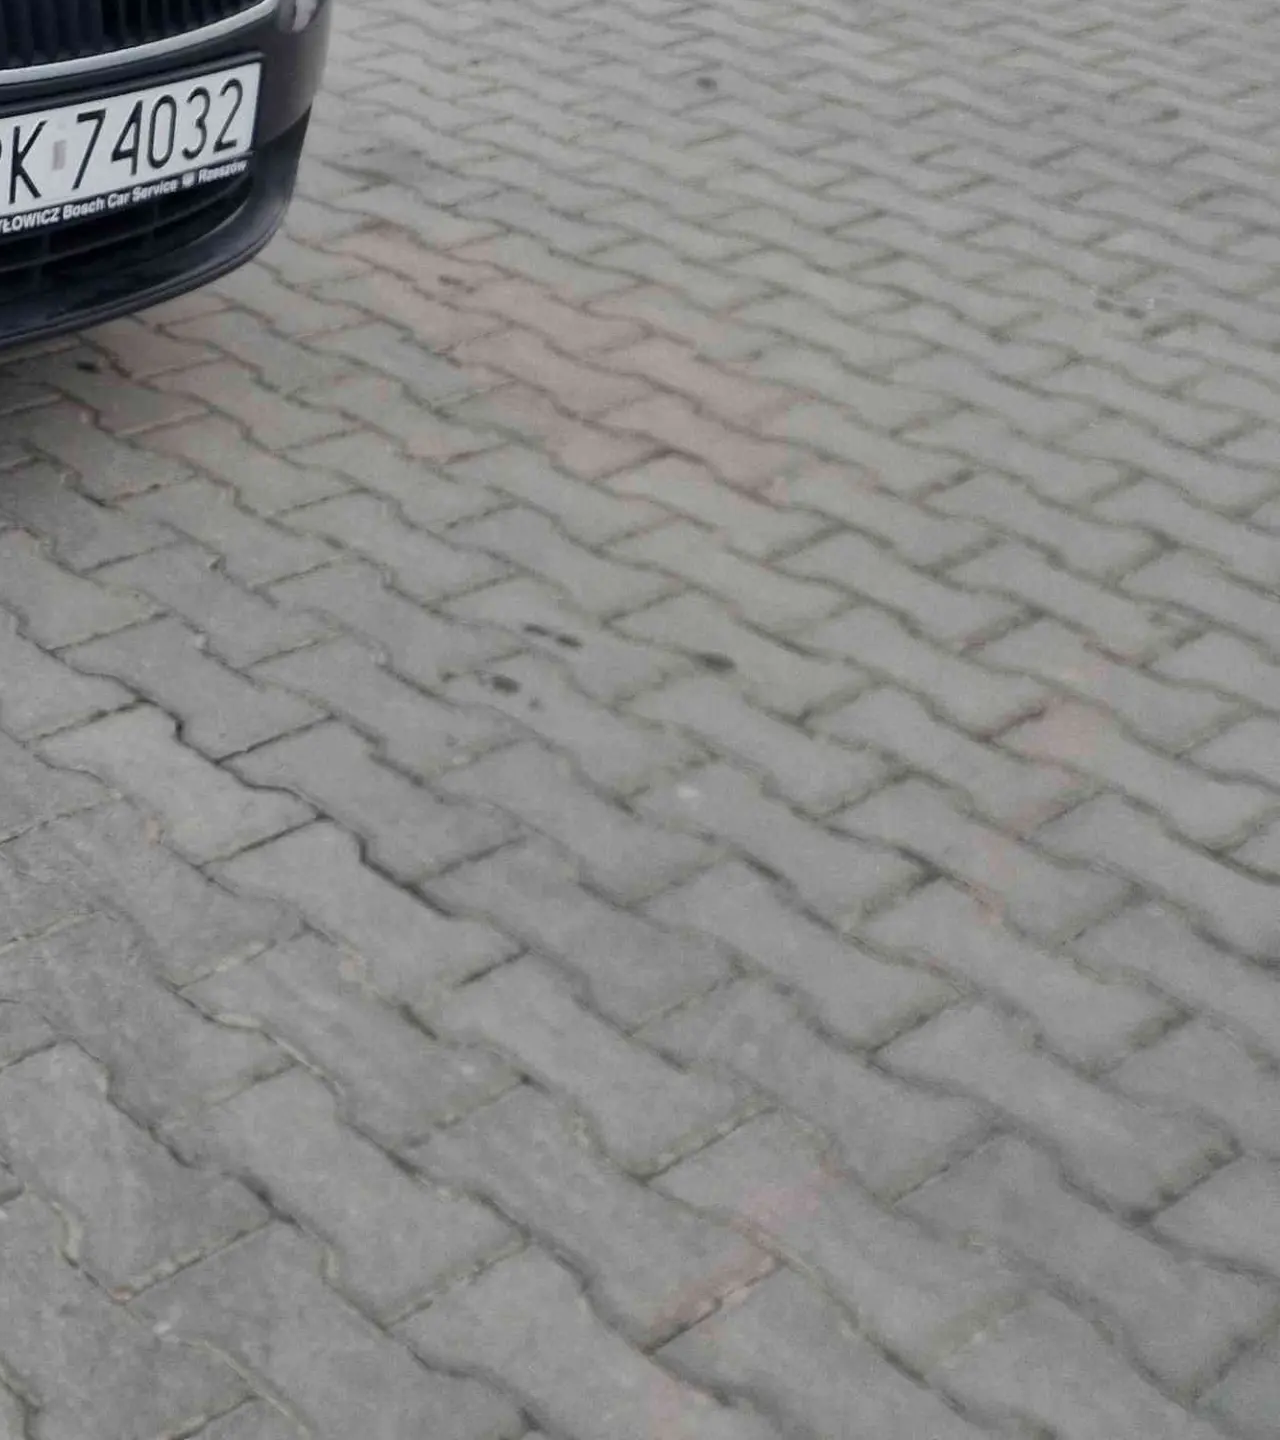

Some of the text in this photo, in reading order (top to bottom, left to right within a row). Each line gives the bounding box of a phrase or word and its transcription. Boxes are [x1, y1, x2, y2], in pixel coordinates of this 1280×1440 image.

[71, 77, 244, 190] 74032
[63, 197, 106, 220] Bosch
[107, 192, 130, 208] Car
[132, 178, 178, 203] Service
